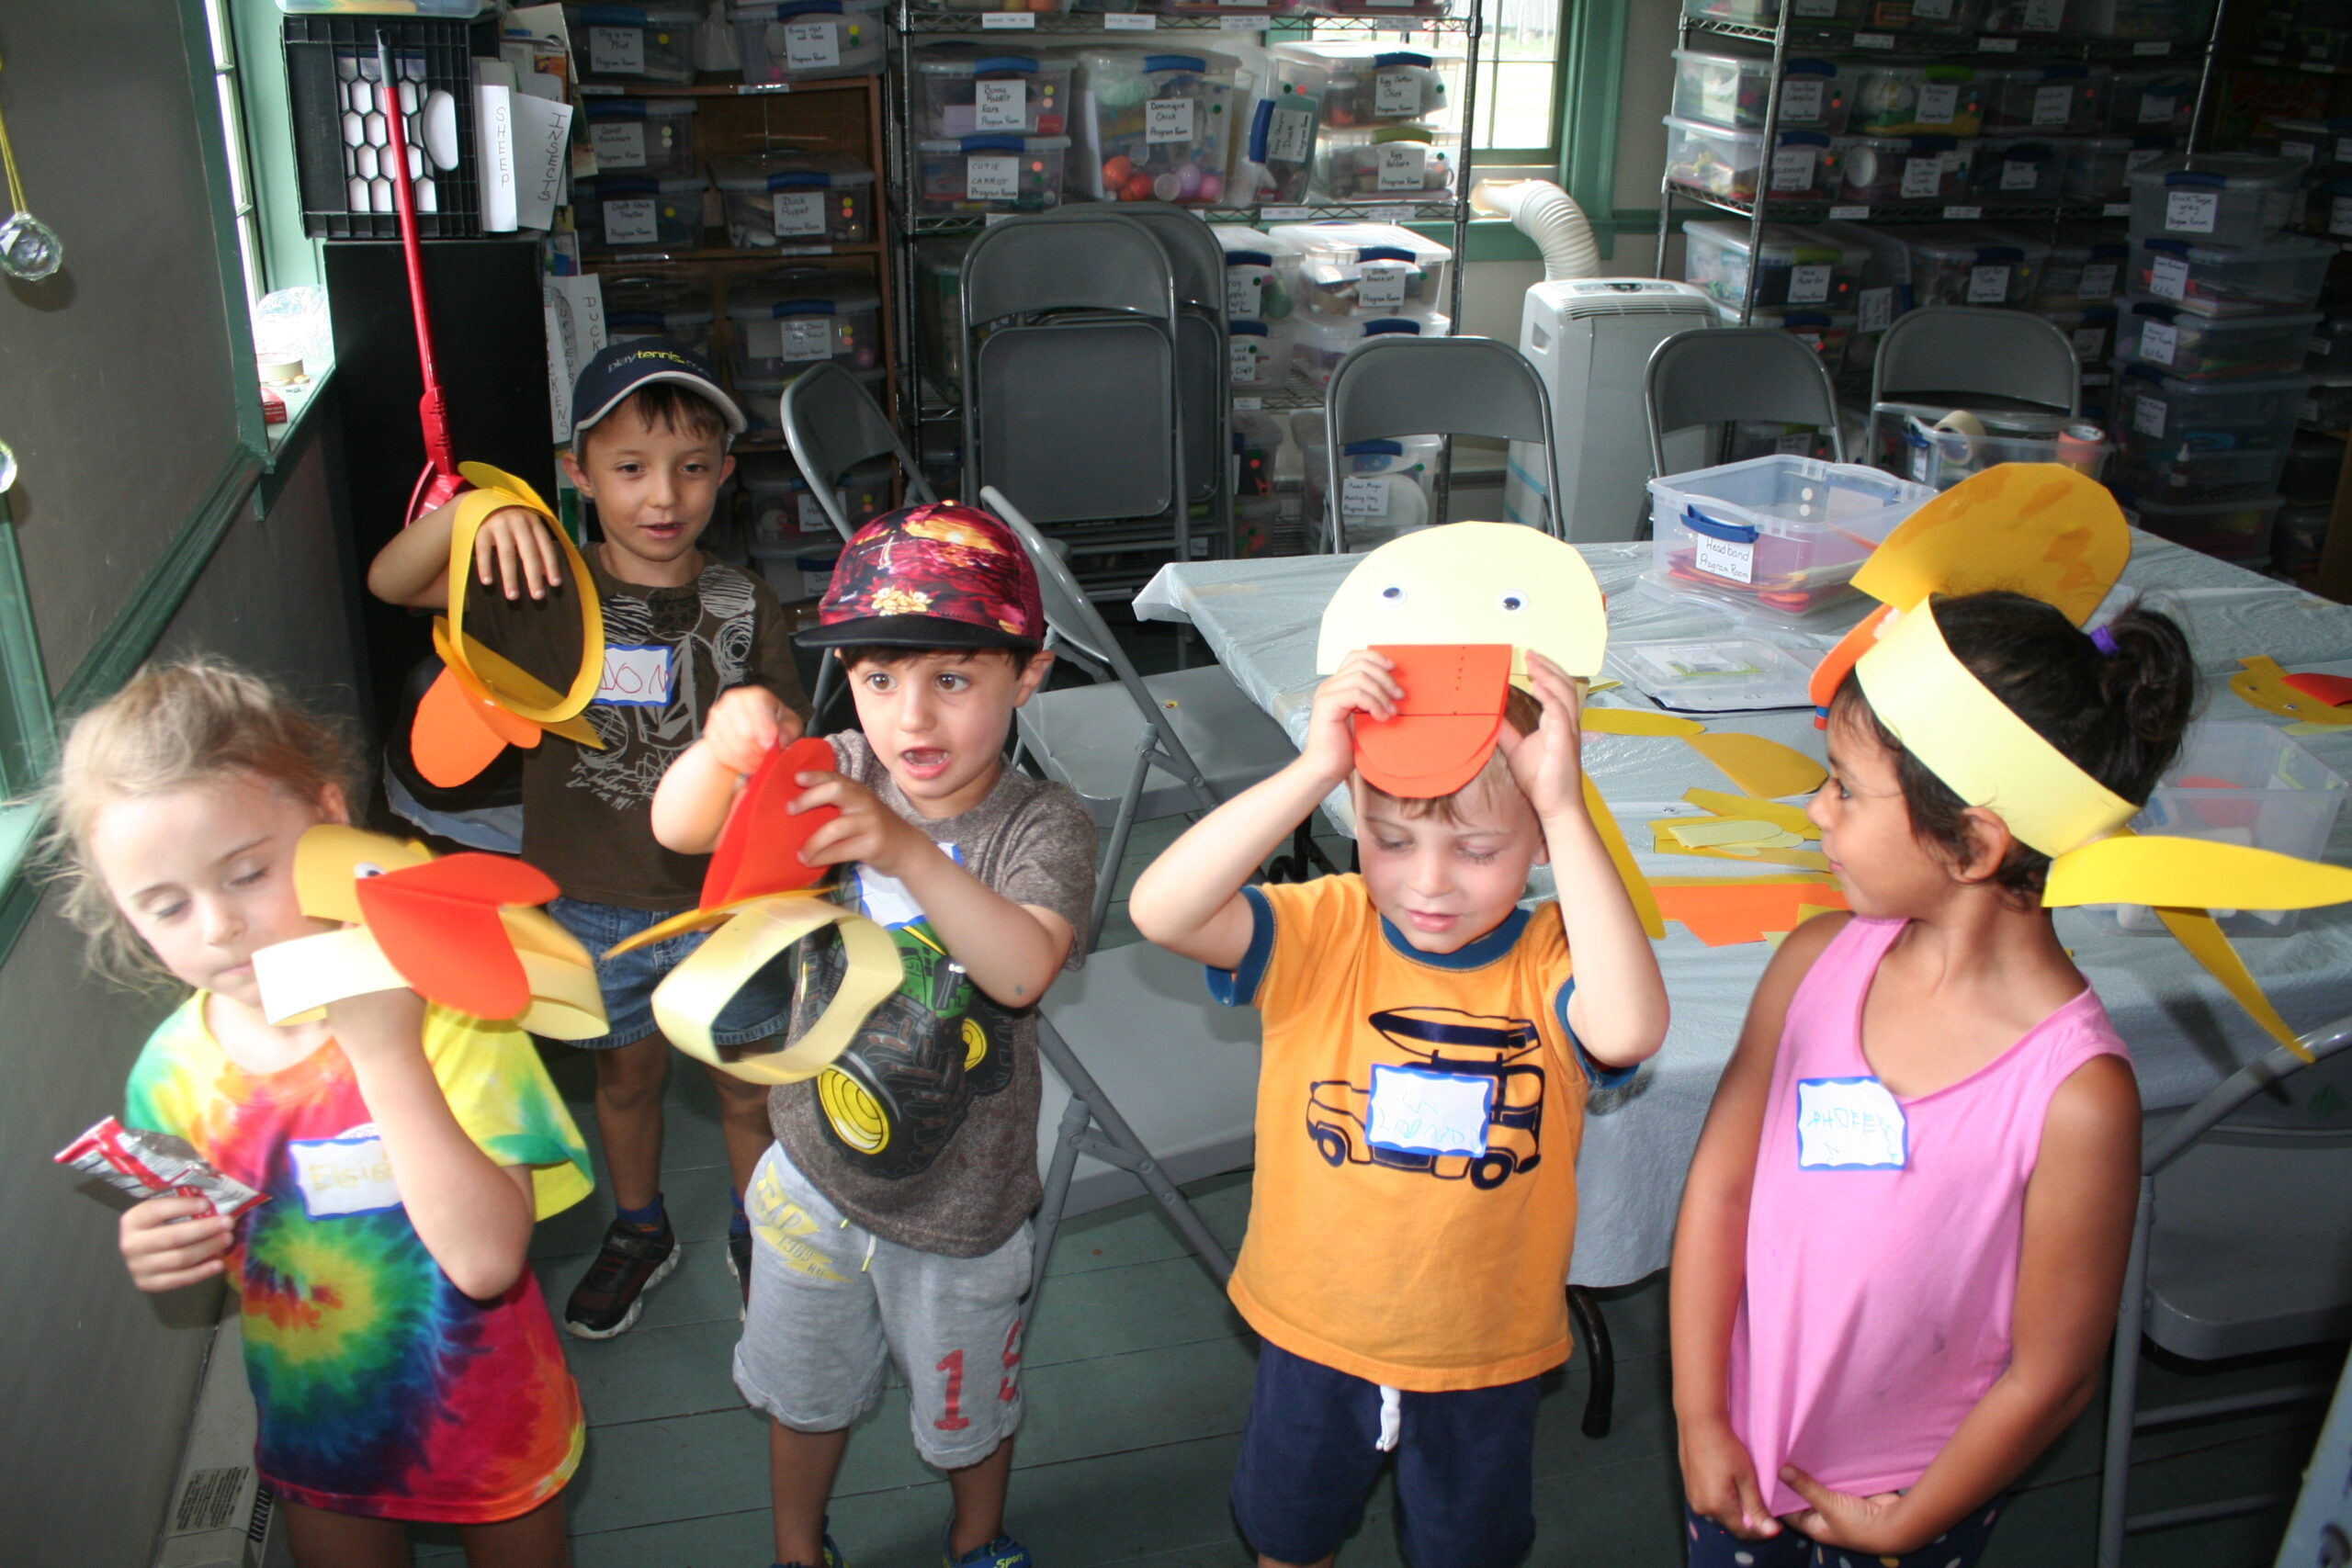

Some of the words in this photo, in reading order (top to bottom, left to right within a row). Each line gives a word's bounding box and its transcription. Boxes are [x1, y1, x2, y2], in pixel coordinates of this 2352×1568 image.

[493, 106, 512, 188] SHEEP
[537, 111, 568, 203] INSECTS
[971, 162, 1001, 171] CUTIE
[971, 177, 1010, 186] CARROT
[582, 296, 601, 352] DUCK
[1700, 552, 1729, 573] Program
[1730, 562, 1750, 581] Room
